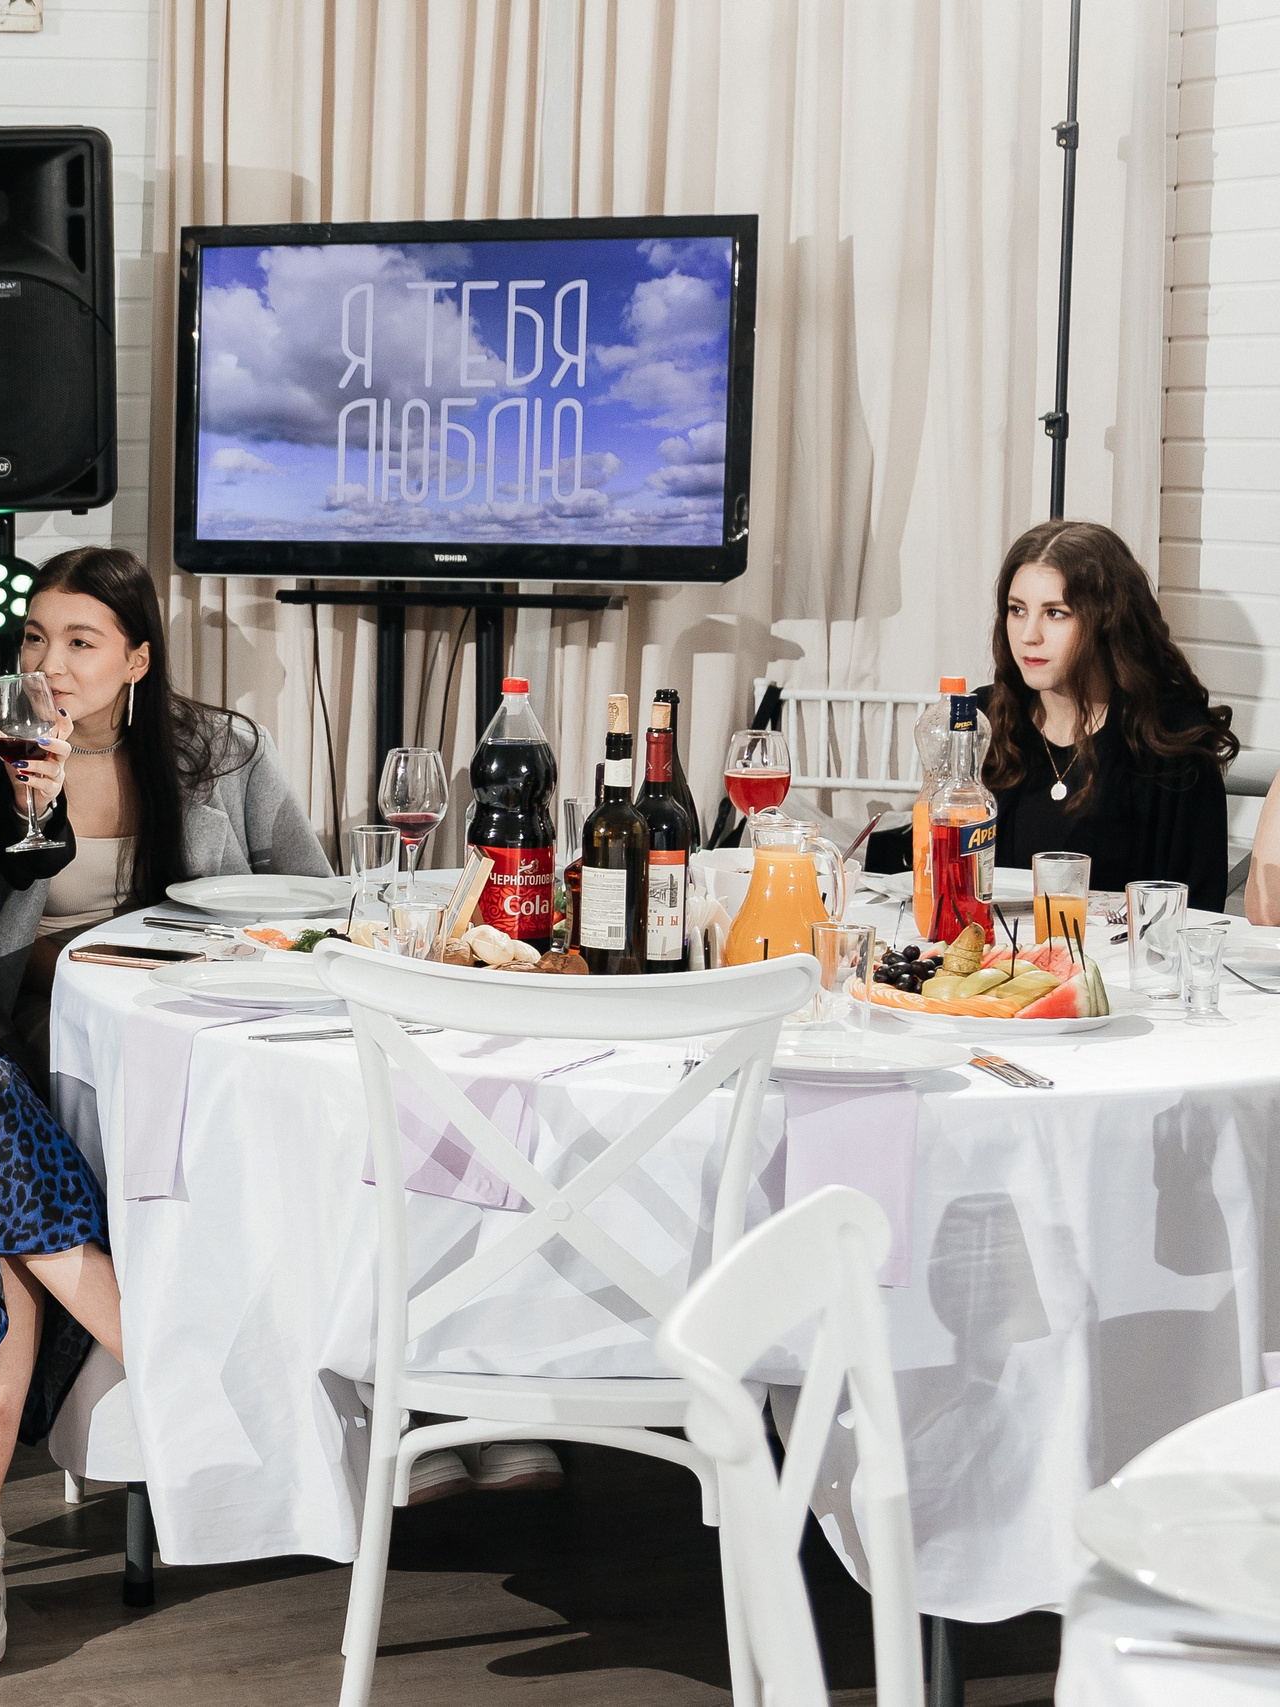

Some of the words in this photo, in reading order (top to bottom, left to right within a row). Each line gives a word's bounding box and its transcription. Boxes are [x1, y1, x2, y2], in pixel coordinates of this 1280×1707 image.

[338, 282, 374, 389] Я
[406, 279, 588, 388] ТЕБЯ
[337, 397, 583, 503] ЛЮБЛЮ
[434, 553, 468, 562] TOSHIBA
[503, 895, 550, 916] Cola
